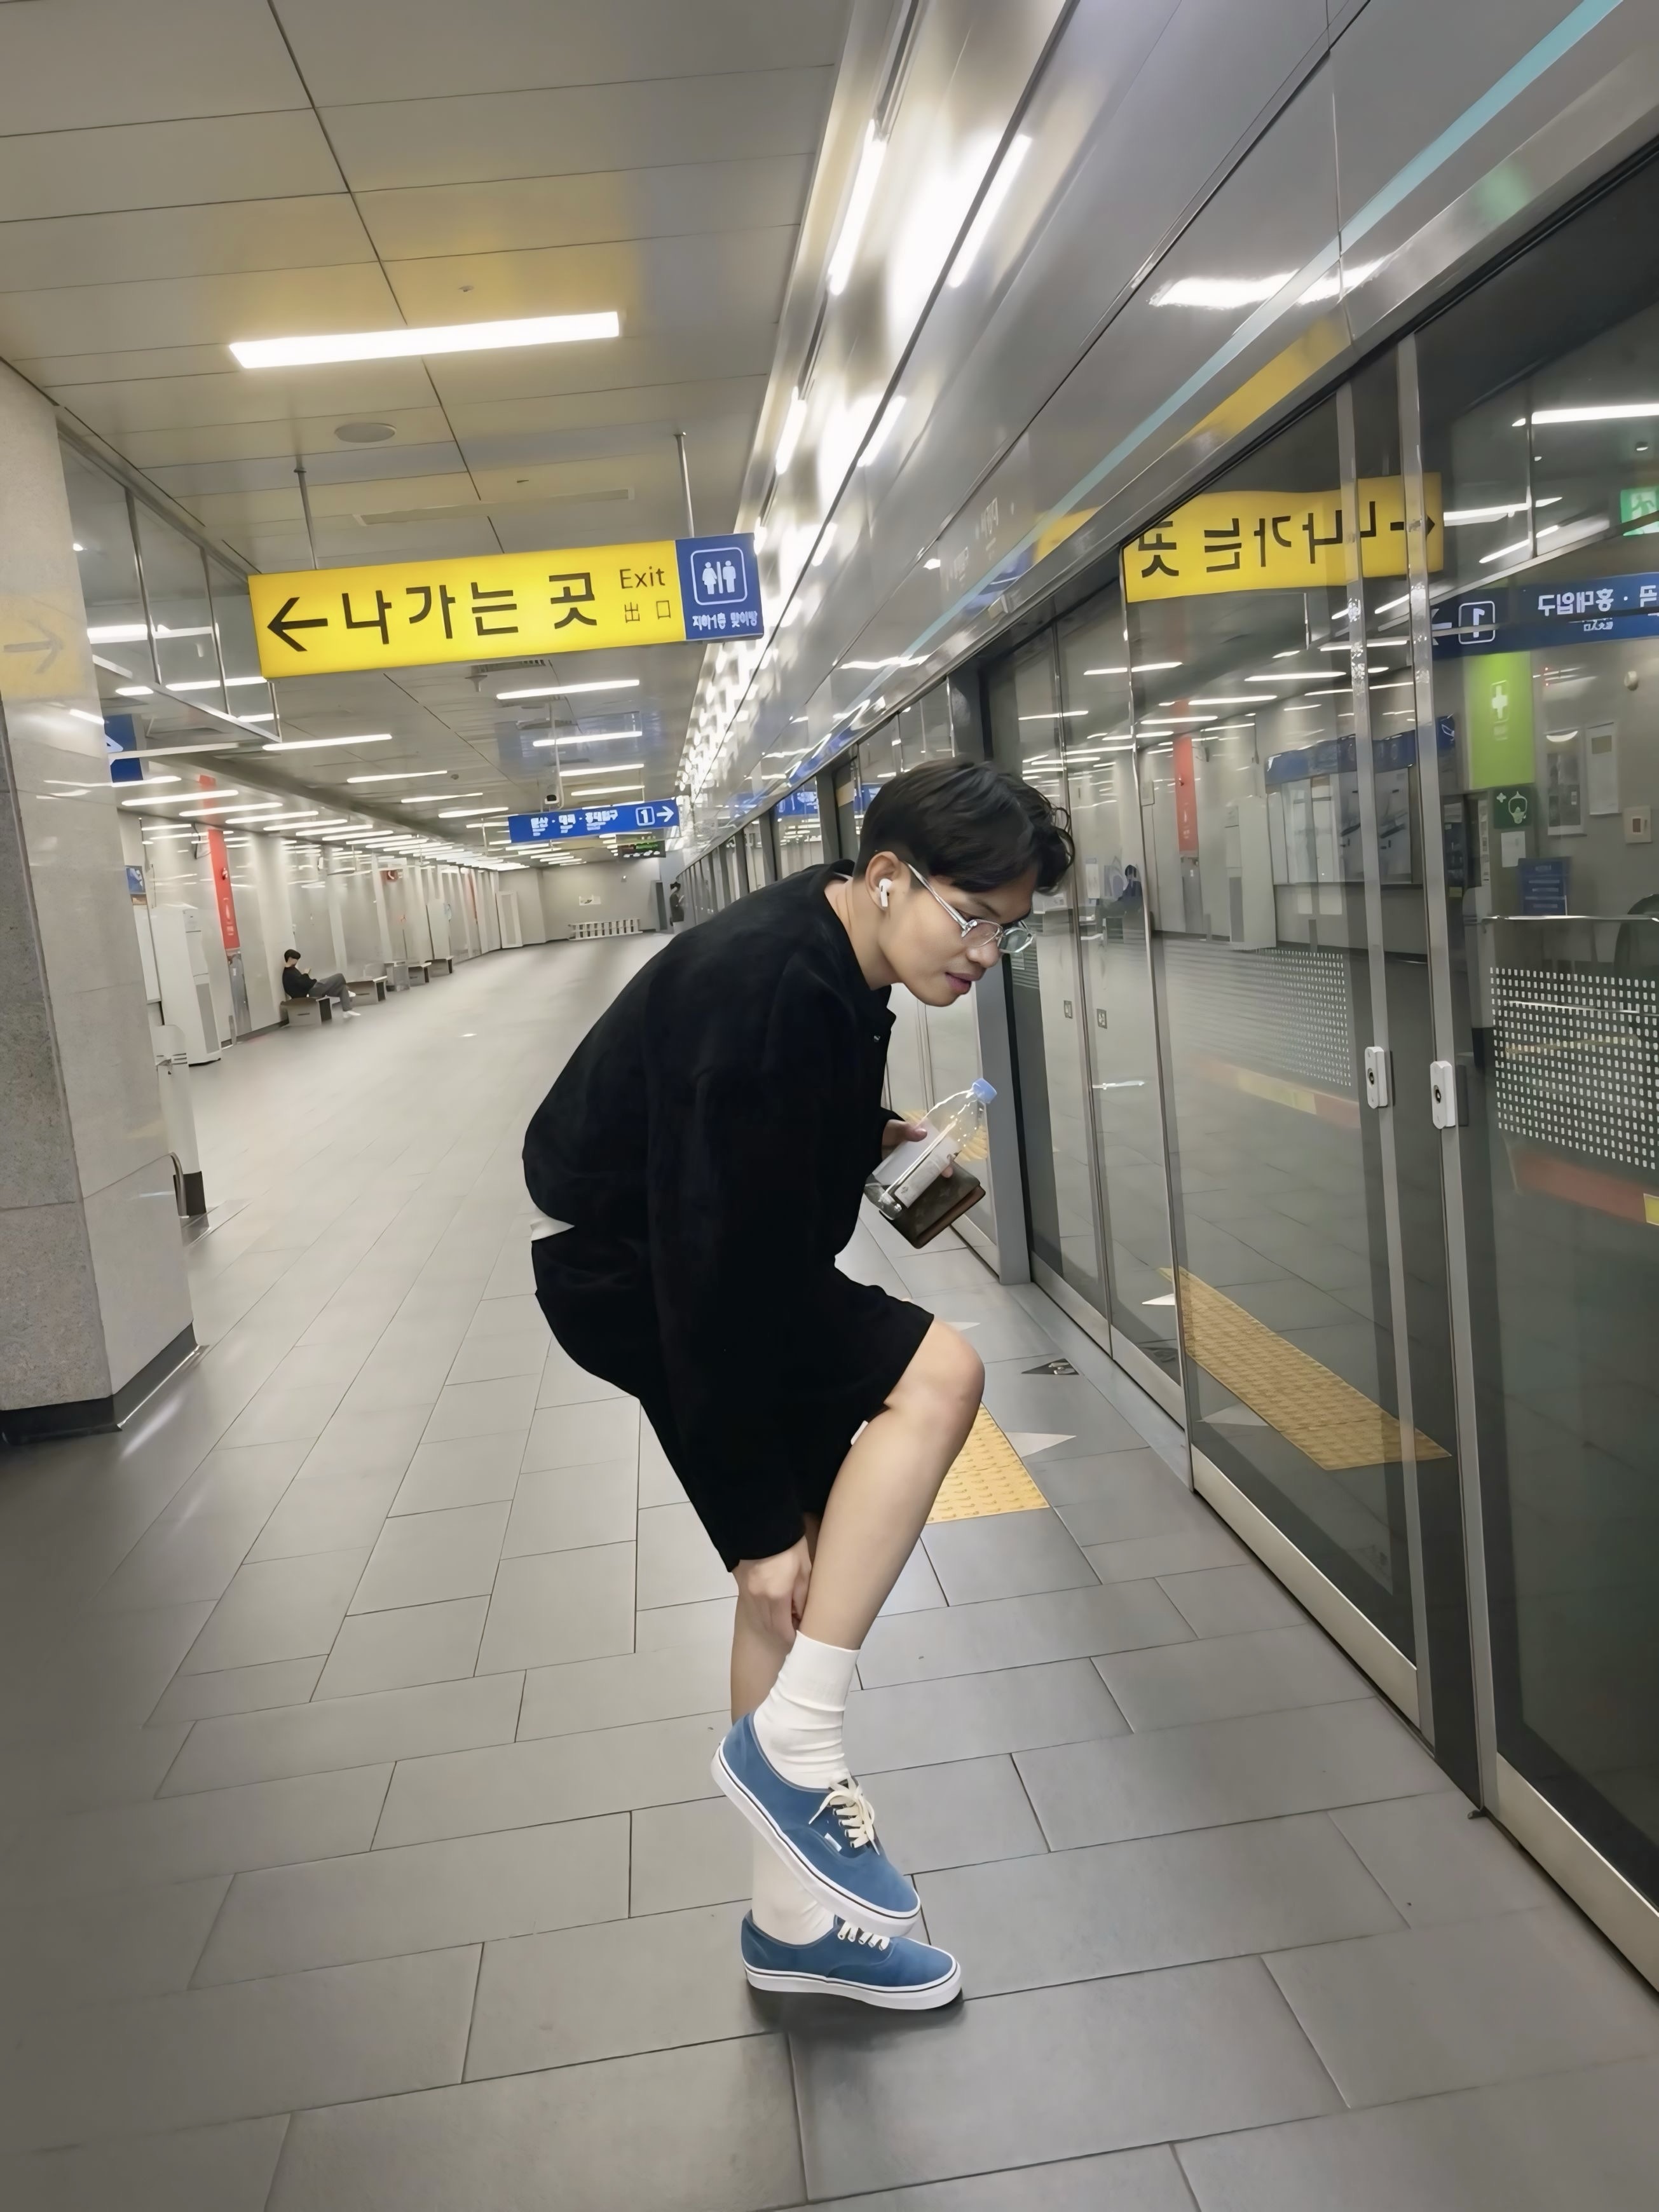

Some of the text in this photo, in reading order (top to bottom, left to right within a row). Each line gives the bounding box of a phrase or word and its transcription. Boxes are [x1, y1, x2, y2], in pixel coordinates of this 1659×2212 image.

[620, 566, 666, 589] Exit
[341, 571, 597, 645] 나가는 곳
[624, 599, 671, 624] 出口
[640, 809, 649, 824] 1
